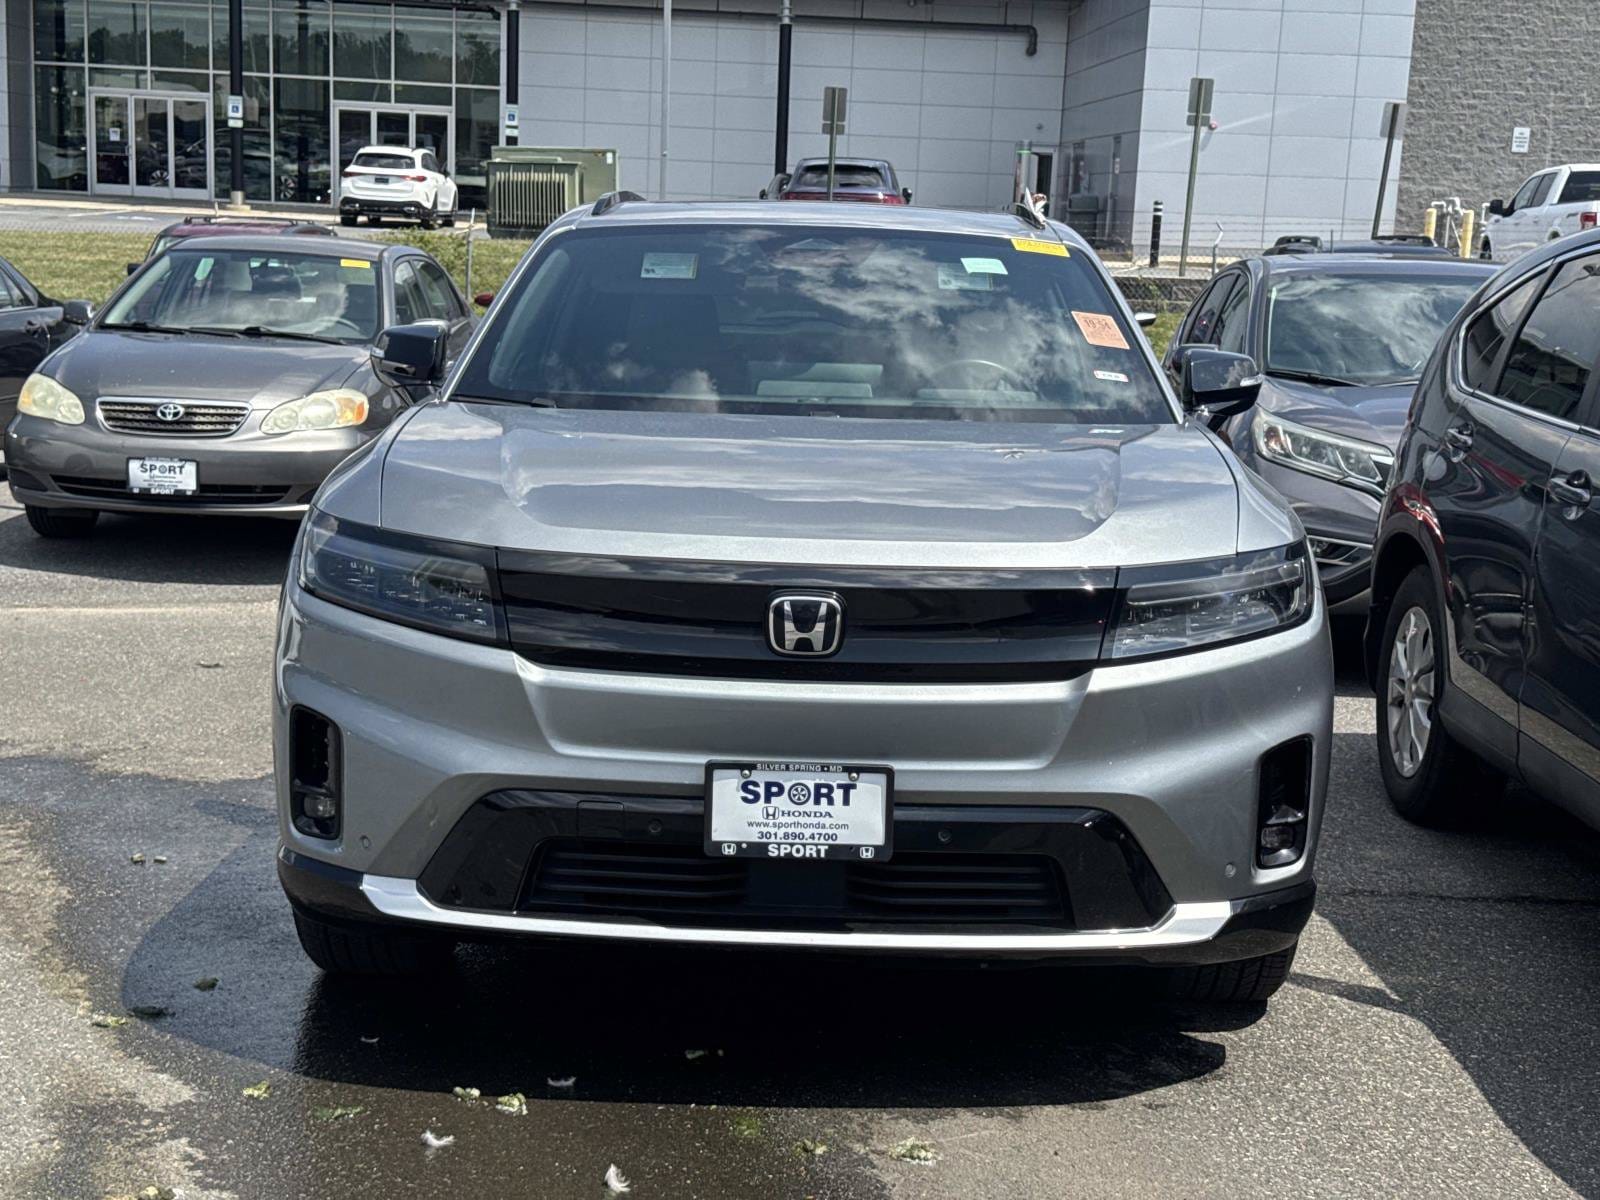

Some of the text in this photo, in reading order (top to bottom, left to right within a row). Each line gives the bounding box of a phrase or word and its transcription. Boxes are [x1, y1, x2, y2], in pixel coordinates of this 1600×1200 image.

[140, 464, 184, 474] SPORT
[756, 763, 843, 773] SILVER SPRING MD
[740, 780, 857, 806] SPORT
[781, 810, 833, 818] HONDA
[747, 820, 849, 830] www.sporthonda.com
[757, 831, 838, 841] 301.890.4700
[768, 843, 828, 858] SPORT
